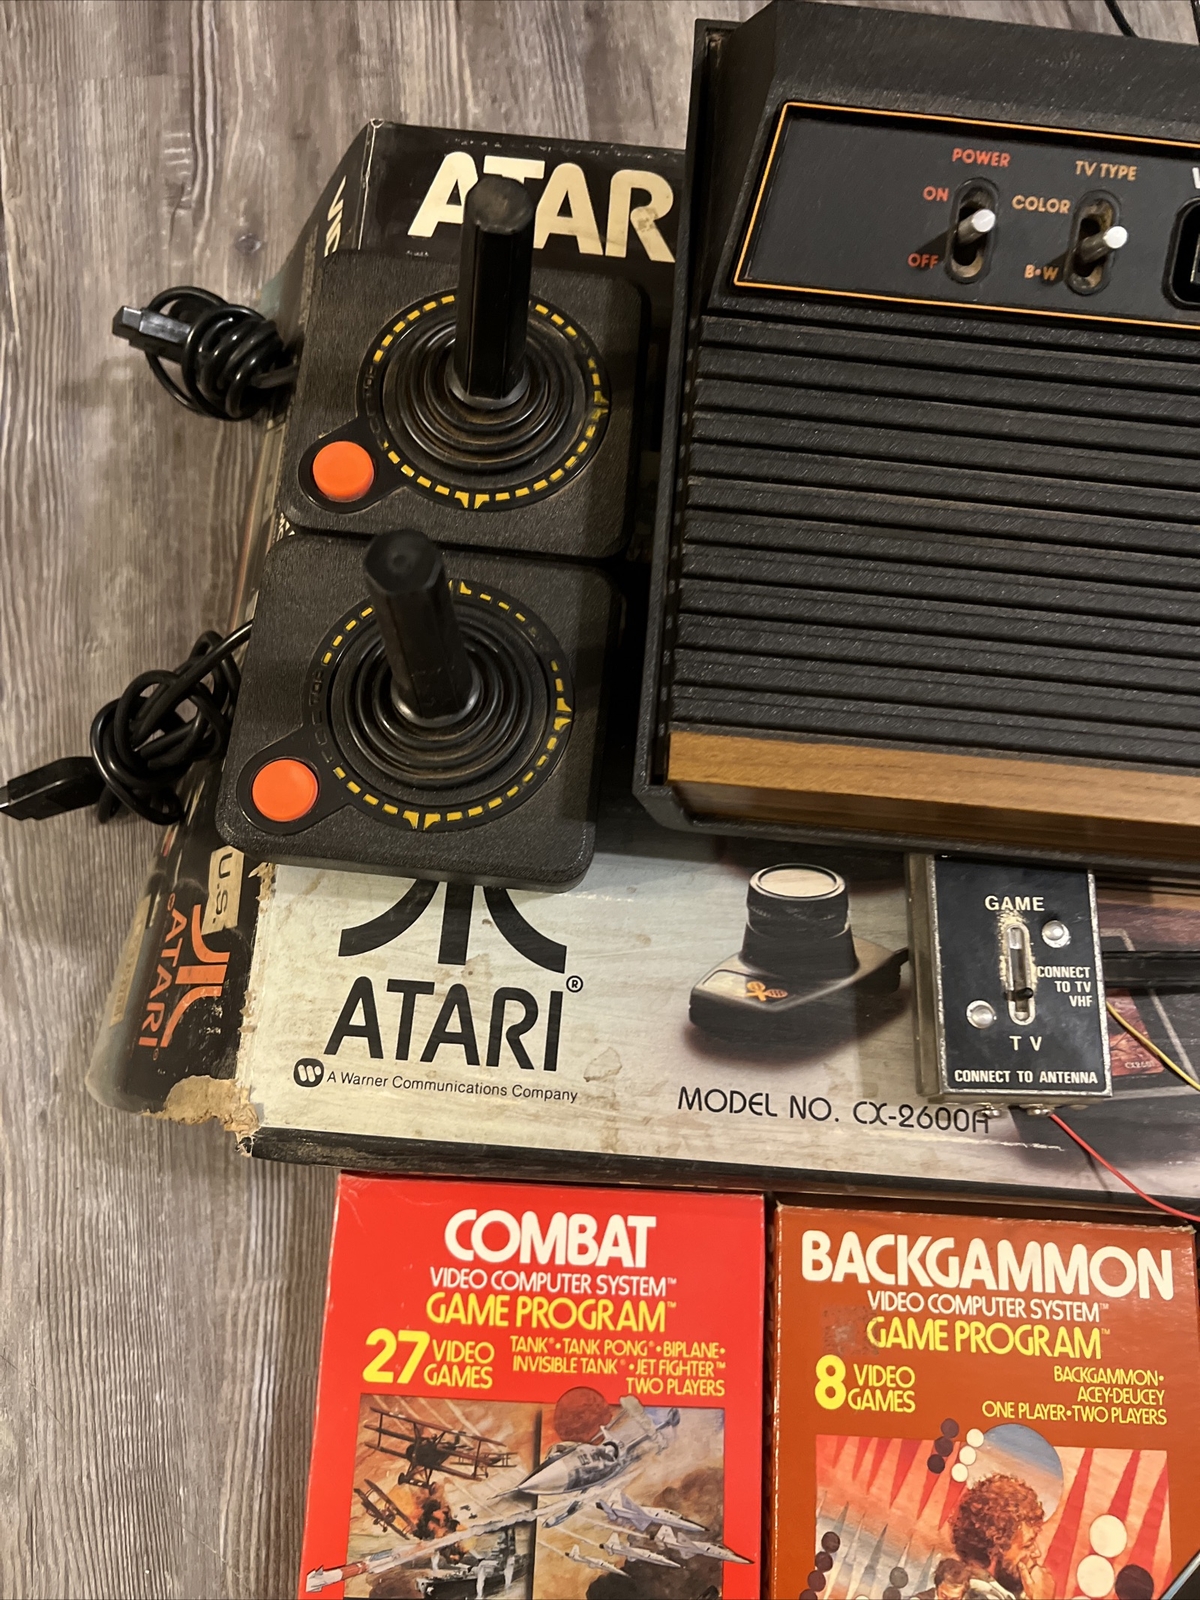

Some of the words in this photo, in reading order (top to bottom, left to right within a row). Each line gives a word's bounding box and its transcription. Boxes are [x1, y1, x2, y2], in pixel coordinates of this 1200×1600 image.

[951, 147, 1011, 168] POWER
[1075, 160, 1097, 178] TV
[1099, 163, 1138, 181] TYPE
[923, 186, 948, 202] ON
[1011, 194, 1071, 214] COLOR
[906, 252, 939, 269] OFF
[212, 852, 233, 924] U.S.
[985, 895, 1045, 912] GAME
[1036, 965, 1091, 979] CONNECT
[1054, 980, 1071, 993] TO
[1072, 980, 1092, 993] TV
[1069, 994, 1093, 1008] VHF
[327, 1071, 337, 1083] A
[340, 1071, 388, 1088] Warner
[392, 1075, 508, 1097] Communications
[511, 1084, 578, 1103] Company
[954, 1069, 1012, 1084] CONNECT
[1016, 1070, 1035, 1084] TO
[1038, 1070, 1098, 1085] ANTENNA
[677, 1086, 778, 1118] MODEL
[790, 1095, 840, 1123] NO.
[853, 1100, 990, 1135] CX-2600A
[444, 1208, 656, 1268] COMBAT
[801, 1230, 1174, 1300] BACKGAMMON
[430, 1266, 487, 1290] VIDEO
[490, 1269, 592, 1295] COMPUTER
[426, 1291, 510, 1328] GAME
[867, 1290, 924, 1312] VIDEO
[927, 1293, 1026, 1319] COMPUTER
[866, 1316, 949, 1352] GAME
[362, 1327, 431, 1384] 27
[432, 1339, 495, 1364] VIDEO
[423, 1364, 493, 1389] GAMES
[512, 1355, 578, 1374] INVISIBLE
[853, 1364, 915, 1388] VIDEO
[626, 1377, 664, 1395] TWO
[667, 1378, 725, 1397] PLAYERS
[814, 1354, 846, 1410] 8
[847, 1389, 916, 1413] GAMES
[1077, 1386, 1164, 1406] ACEY-DEUCEY
[982, 1401, 1015, 1420] ONE
[1110, 1406, 1168, 1426] PLAYERS
